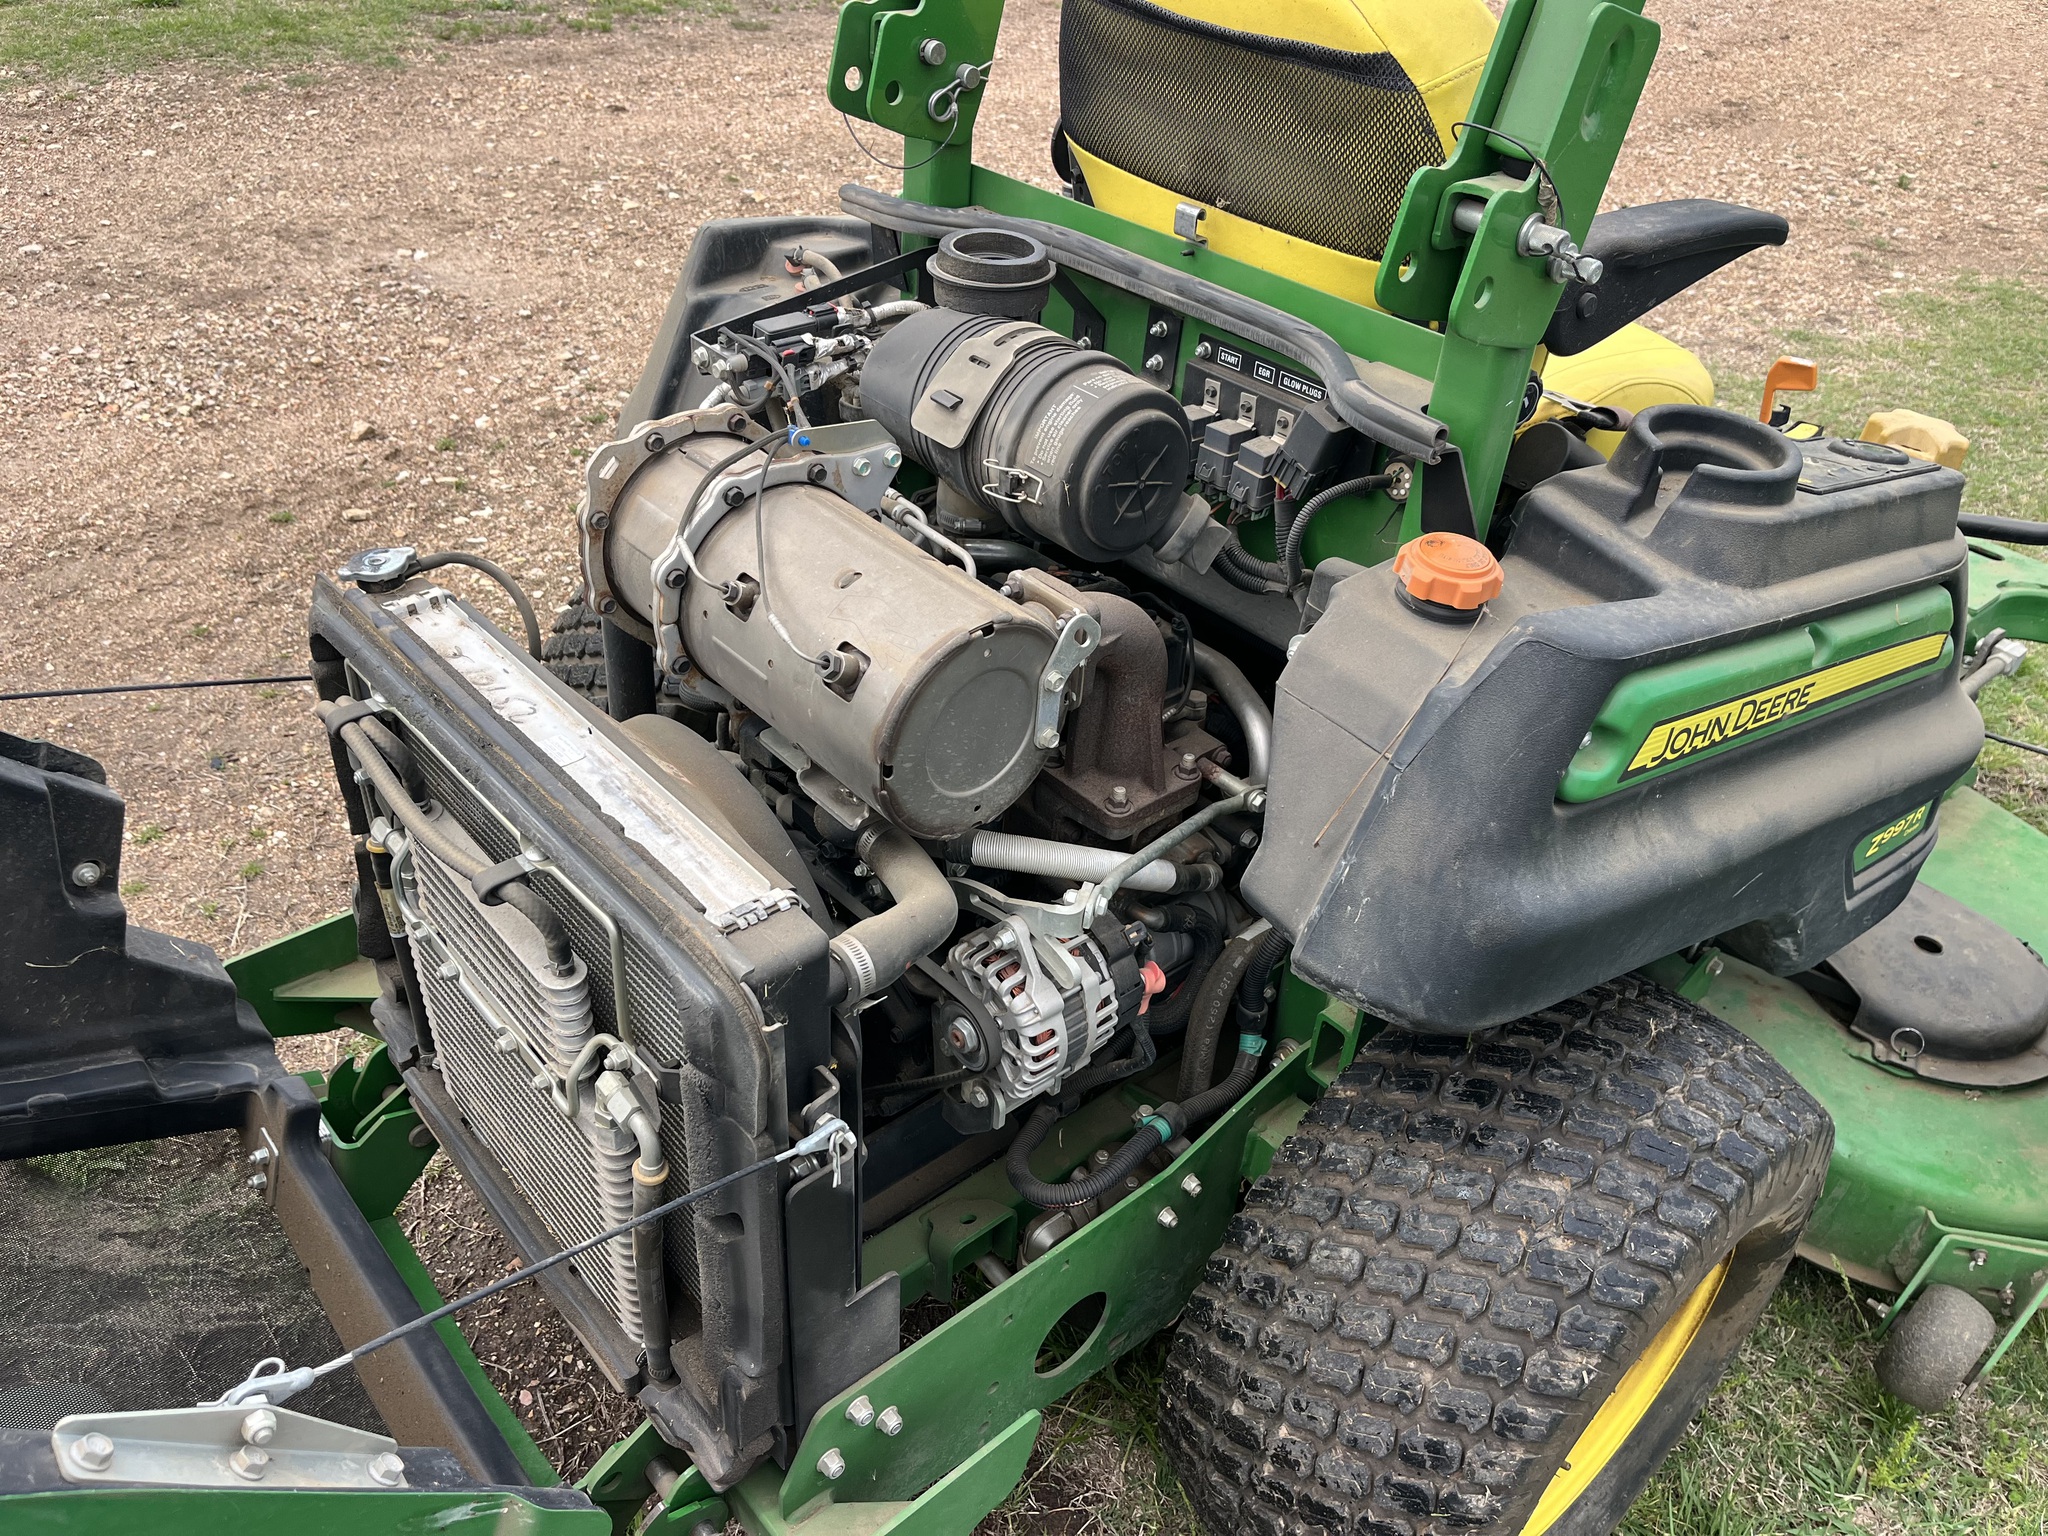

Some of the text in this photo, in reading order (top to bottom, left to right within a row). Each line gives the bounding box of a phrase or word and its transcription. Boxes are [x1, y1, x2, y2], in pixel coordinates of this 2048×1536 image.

[1220, 352, 1239, 366] START
[1258, 367, 1271, 379] EGR
[1283, 376, 1323, 400] GLOW PLUGS
[1034, 404, 1057, 439] IMPORTANT
[1054, 405, 1071, 426] starting
[1063, 406, 1081, 427] reaches
[1034, 432, 1045, 456] prevent
[1044, 412, 1057, 432] engine
[1651, 682, 1817, 764] JOHN DEERE
[1865, 805, 1927, 858] Z997R
[1217, 971, 1234, 996] PSI)
